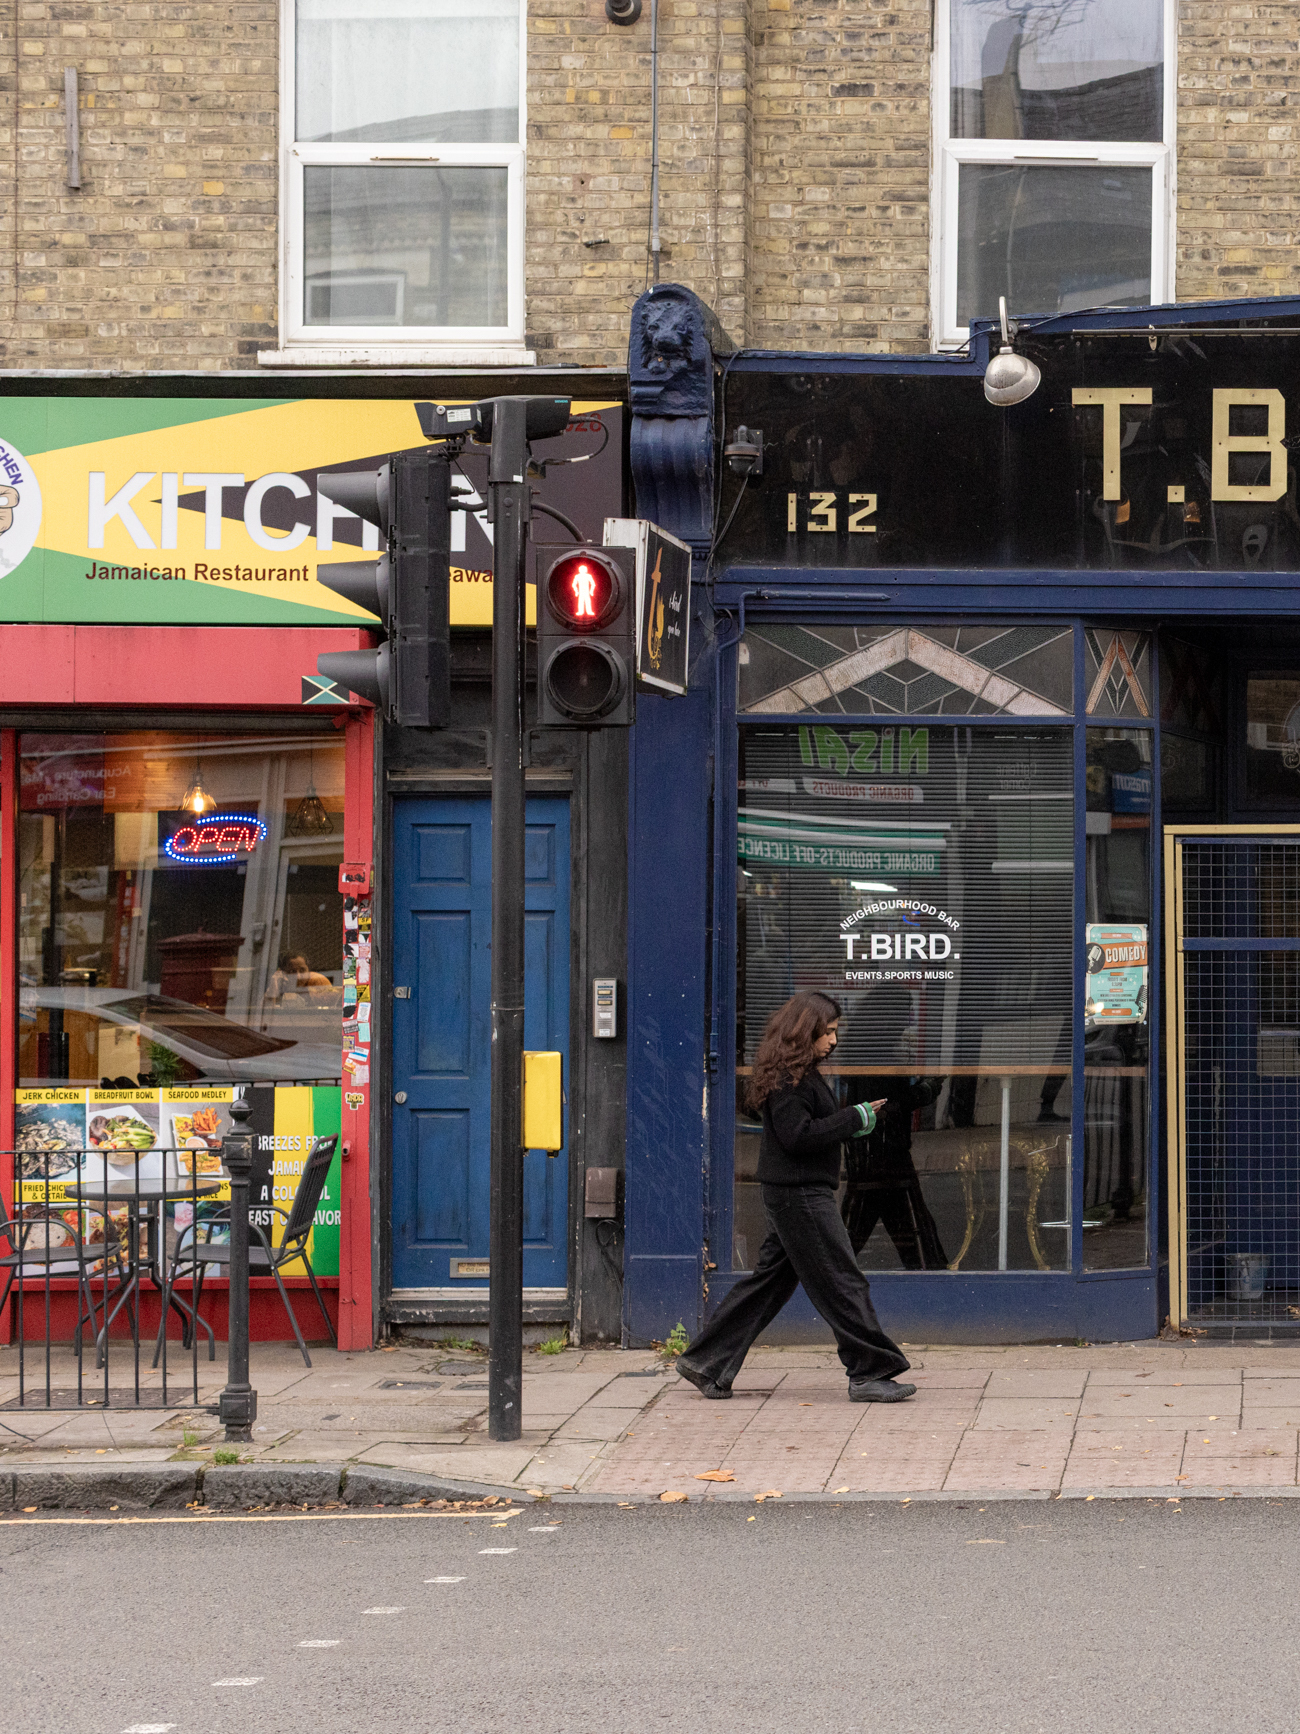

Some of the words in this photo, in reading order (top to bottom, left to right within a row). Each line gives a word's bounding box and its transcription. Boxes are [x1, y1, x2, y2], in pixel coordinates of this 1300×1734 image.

[88, 471, 494, 552] KITCHN
[787, 492, 877, 533] 132
[85, 562, 187, 583] Jamaican
[193, 562, 309, 583] Restaurant
[172, 826, 261, 852] OPEN
[840, 900, 937, 931] NEIGHBOURHOOD
[937, 911, 960, 931] BAR
[840, 933, 960, 960] T.BIRD.
[1105, 945, 1146, 963] COMEDY
[924, 971, 954, 979] MUSIC
[22, 1092, 43, 1100] JERK
[45, 1091, 80, 1100] CHICKEN
[94, 1091, 133, 1100] BREADFRUIT
[135, 1091, 154, 1099] BOWL
[168, 1090, 199, 1099] SEAFOOD
[201, 1090, 227, 1099] MEDLEY
[268, 1160, 306, 1176] JAMAI
[24, 1184, 44, 1192] FRIED
[32, 1192, 38, 1200] &
[261, 1185, 268, 1200] A
[248, 1210, 275, 1226] EAST
